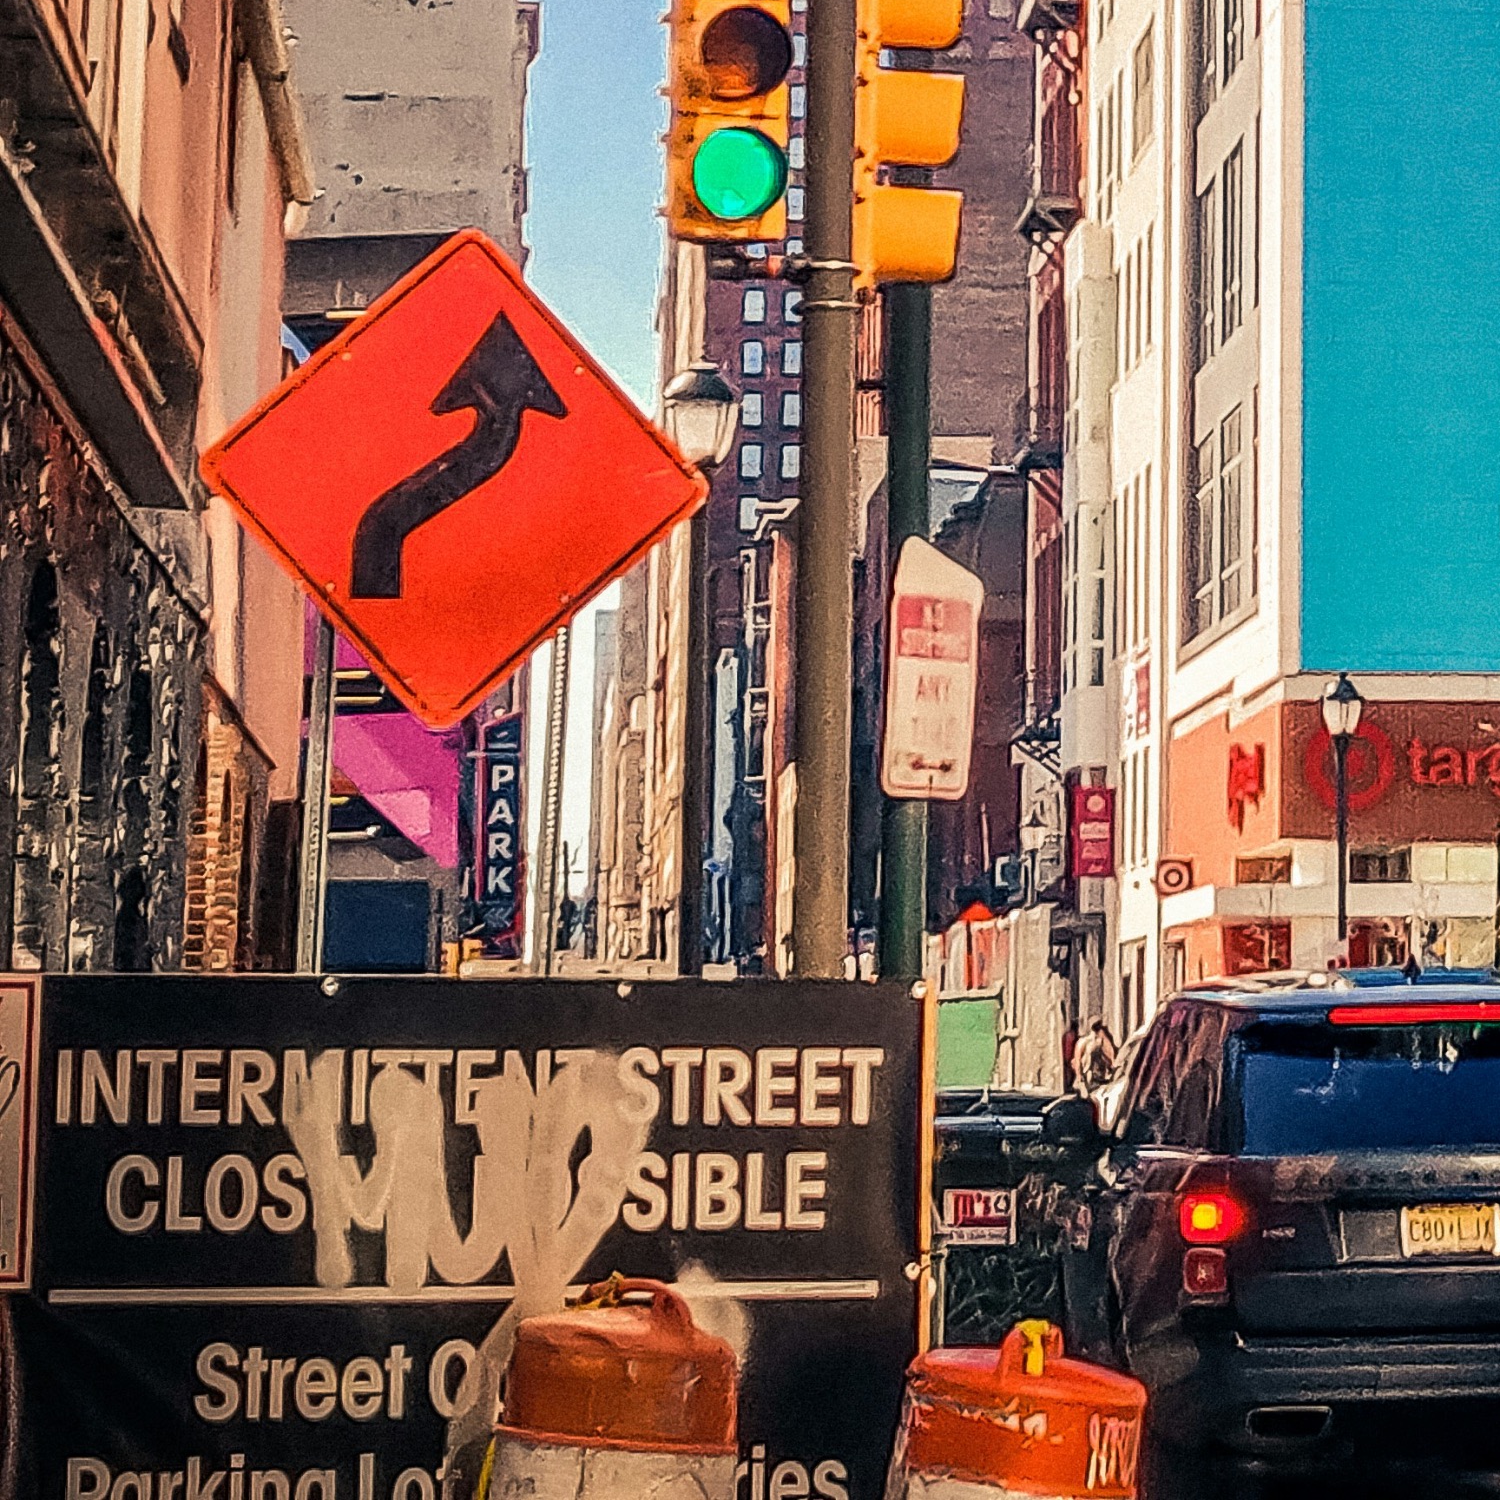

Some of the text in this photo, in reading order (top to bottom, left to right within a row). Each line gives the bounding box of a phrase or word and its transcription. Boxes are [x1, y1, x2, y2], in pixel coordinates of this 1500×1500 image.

[486, 764, 515, 895] PARK
[617, 1047, 884, 1126] STREET
[106, 1152, 828, 1233] CLOS SIBLE
[194, 1342, 412, 1421] Street
